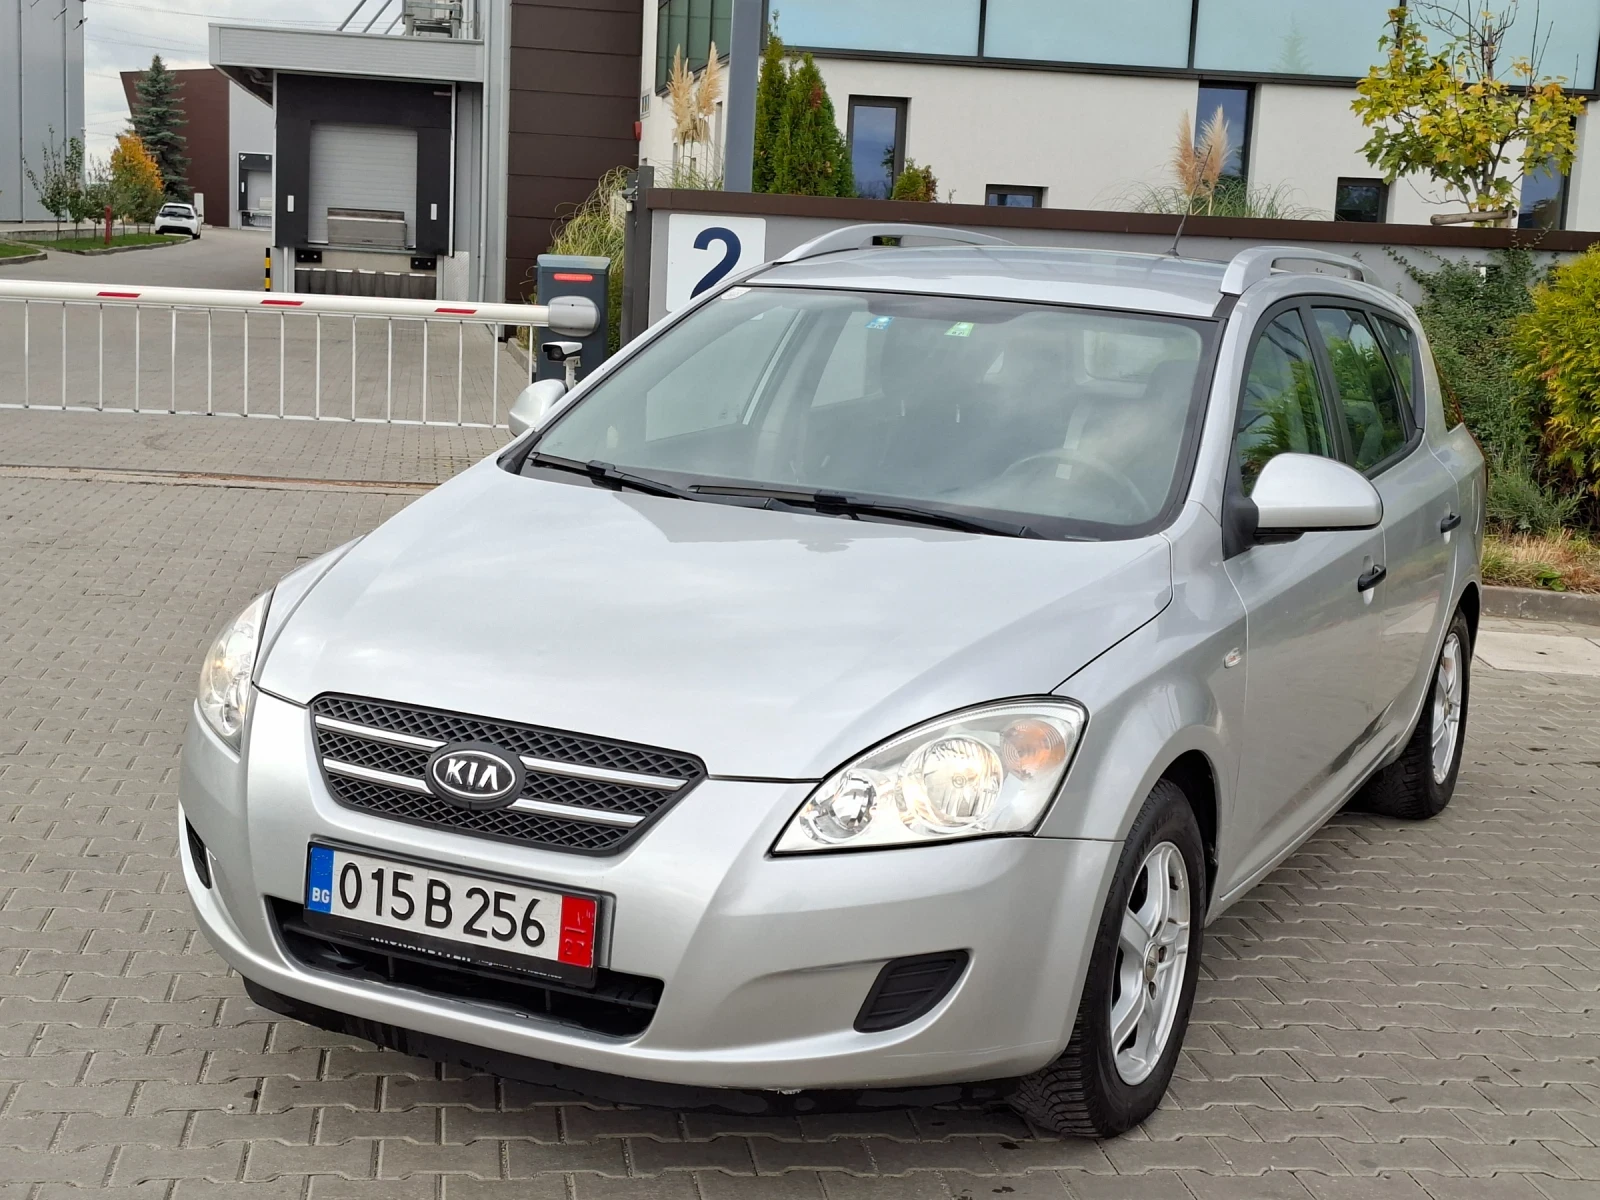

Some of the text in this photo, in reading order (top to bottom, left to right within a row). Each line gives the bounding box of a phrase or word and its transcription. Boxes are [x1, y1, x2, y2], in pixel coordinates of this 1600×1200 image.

[690, 226, 742, 300] 2
[444, 758, 499, 791] KIA
[311, 887, 330, 903] BG
